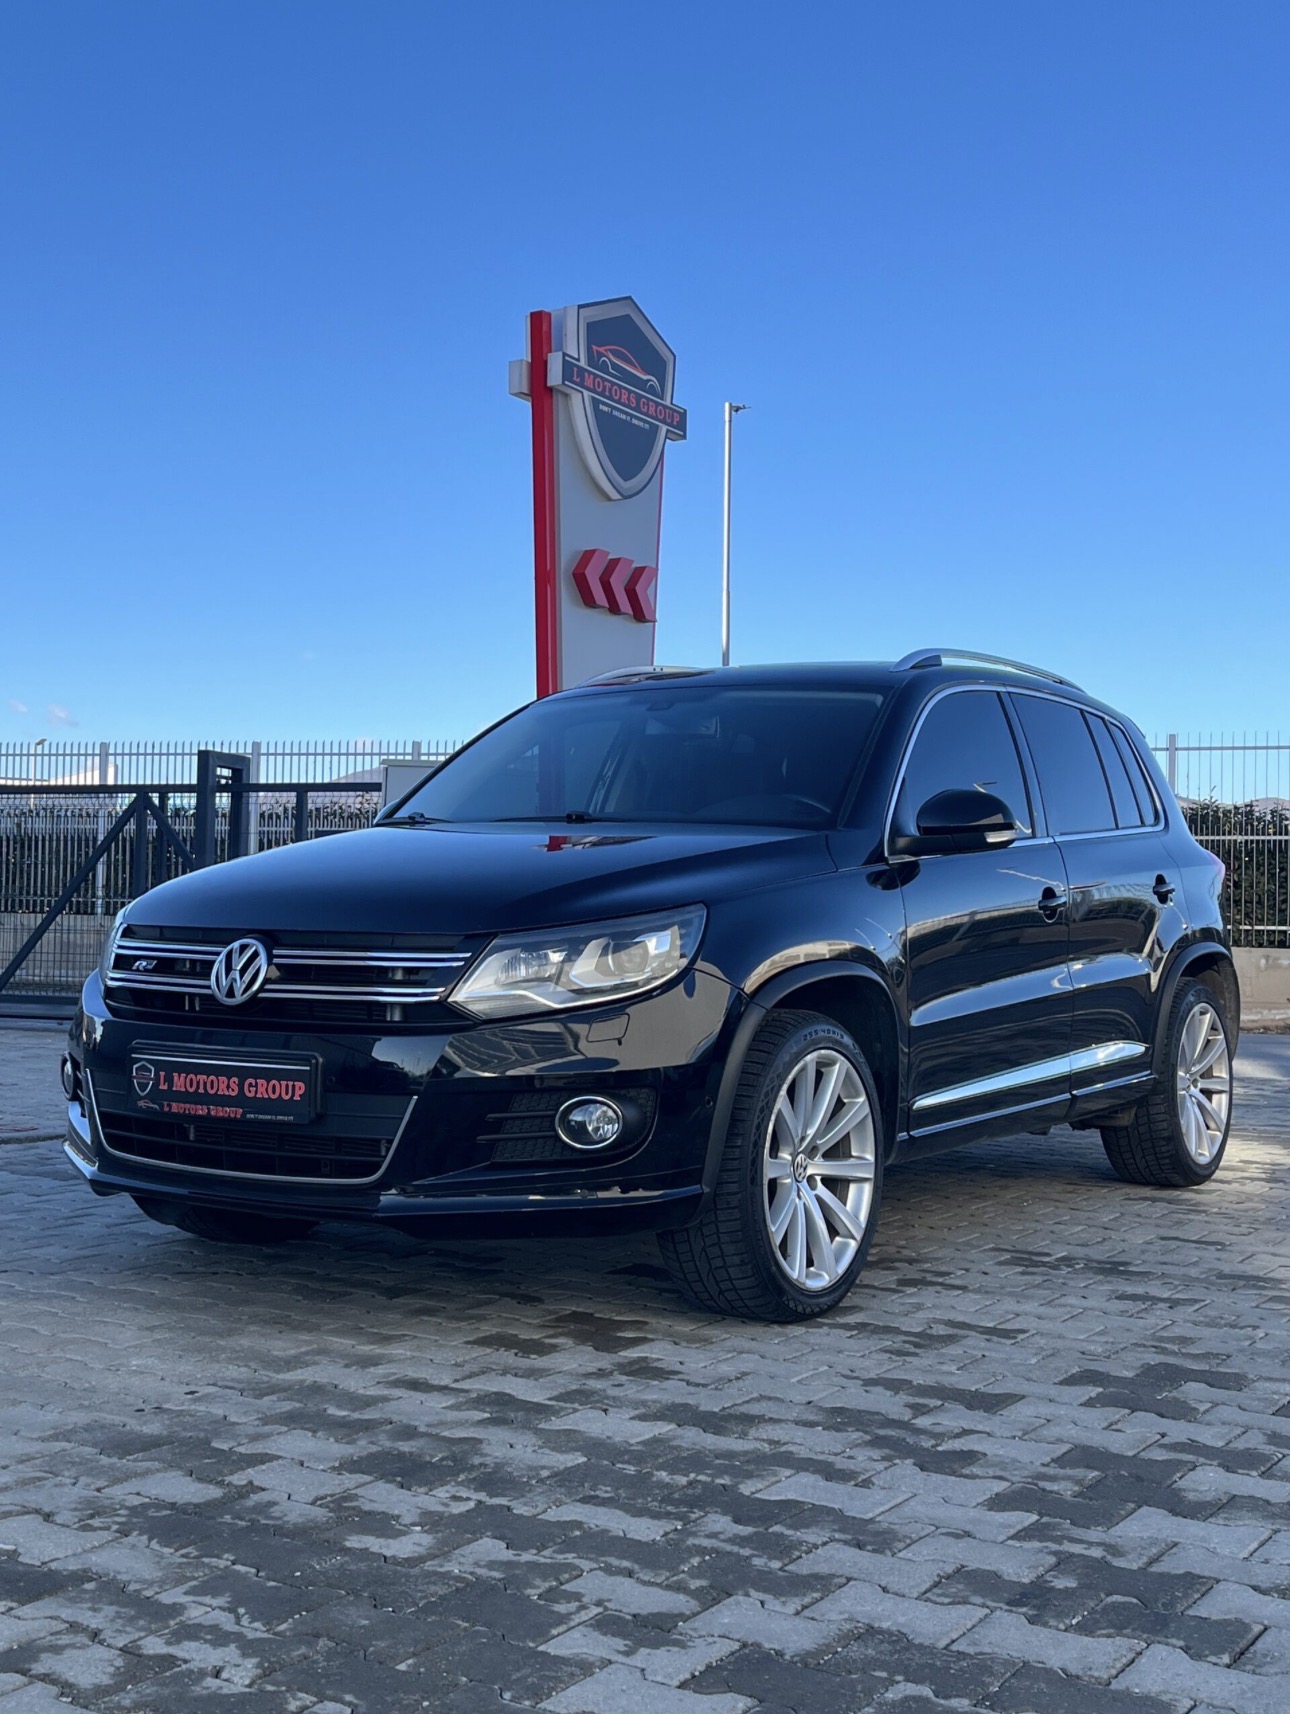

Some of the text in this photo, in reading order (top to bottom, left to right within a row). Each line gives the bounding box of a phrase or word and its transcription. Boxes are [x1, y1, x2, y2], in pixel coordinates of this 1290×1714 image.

[573, 367, 680, 425] L MOTORS GROUP
[159, 1072, 168, 1090] L
[172, 1073, 239, 1096] MOTORS
[244, 1078, 306, 1100] GROUP
[163, 1101, 170, 1111] L
[171, 1103, 208, 1116] MOTORS
[209, 1106, 243, 1118] GROUP
